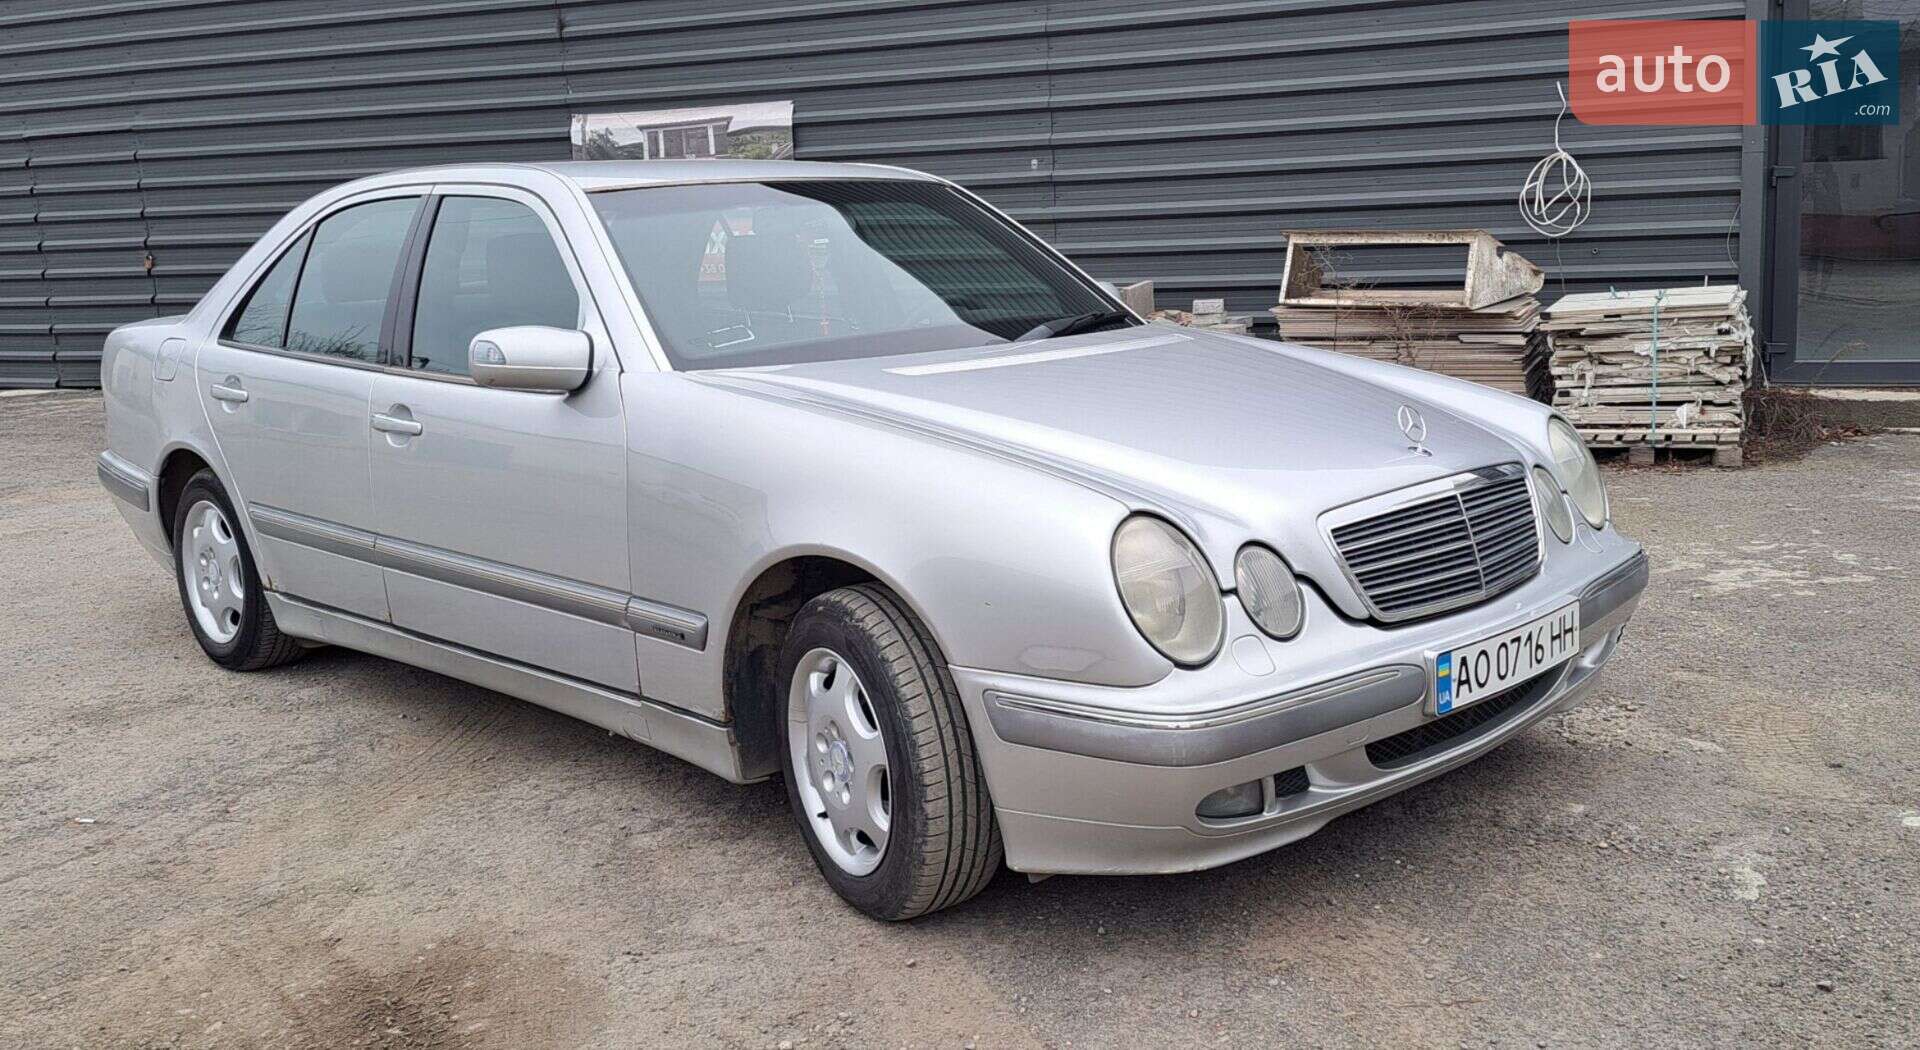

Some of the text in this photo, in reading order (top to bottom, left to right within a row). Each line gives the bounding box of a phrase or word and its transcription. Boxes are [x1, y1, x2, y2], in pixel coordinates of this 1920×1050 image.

[1456, 610, 1574, 699] AO 0716 HH
[1439, 690, 1451, 705] UA
